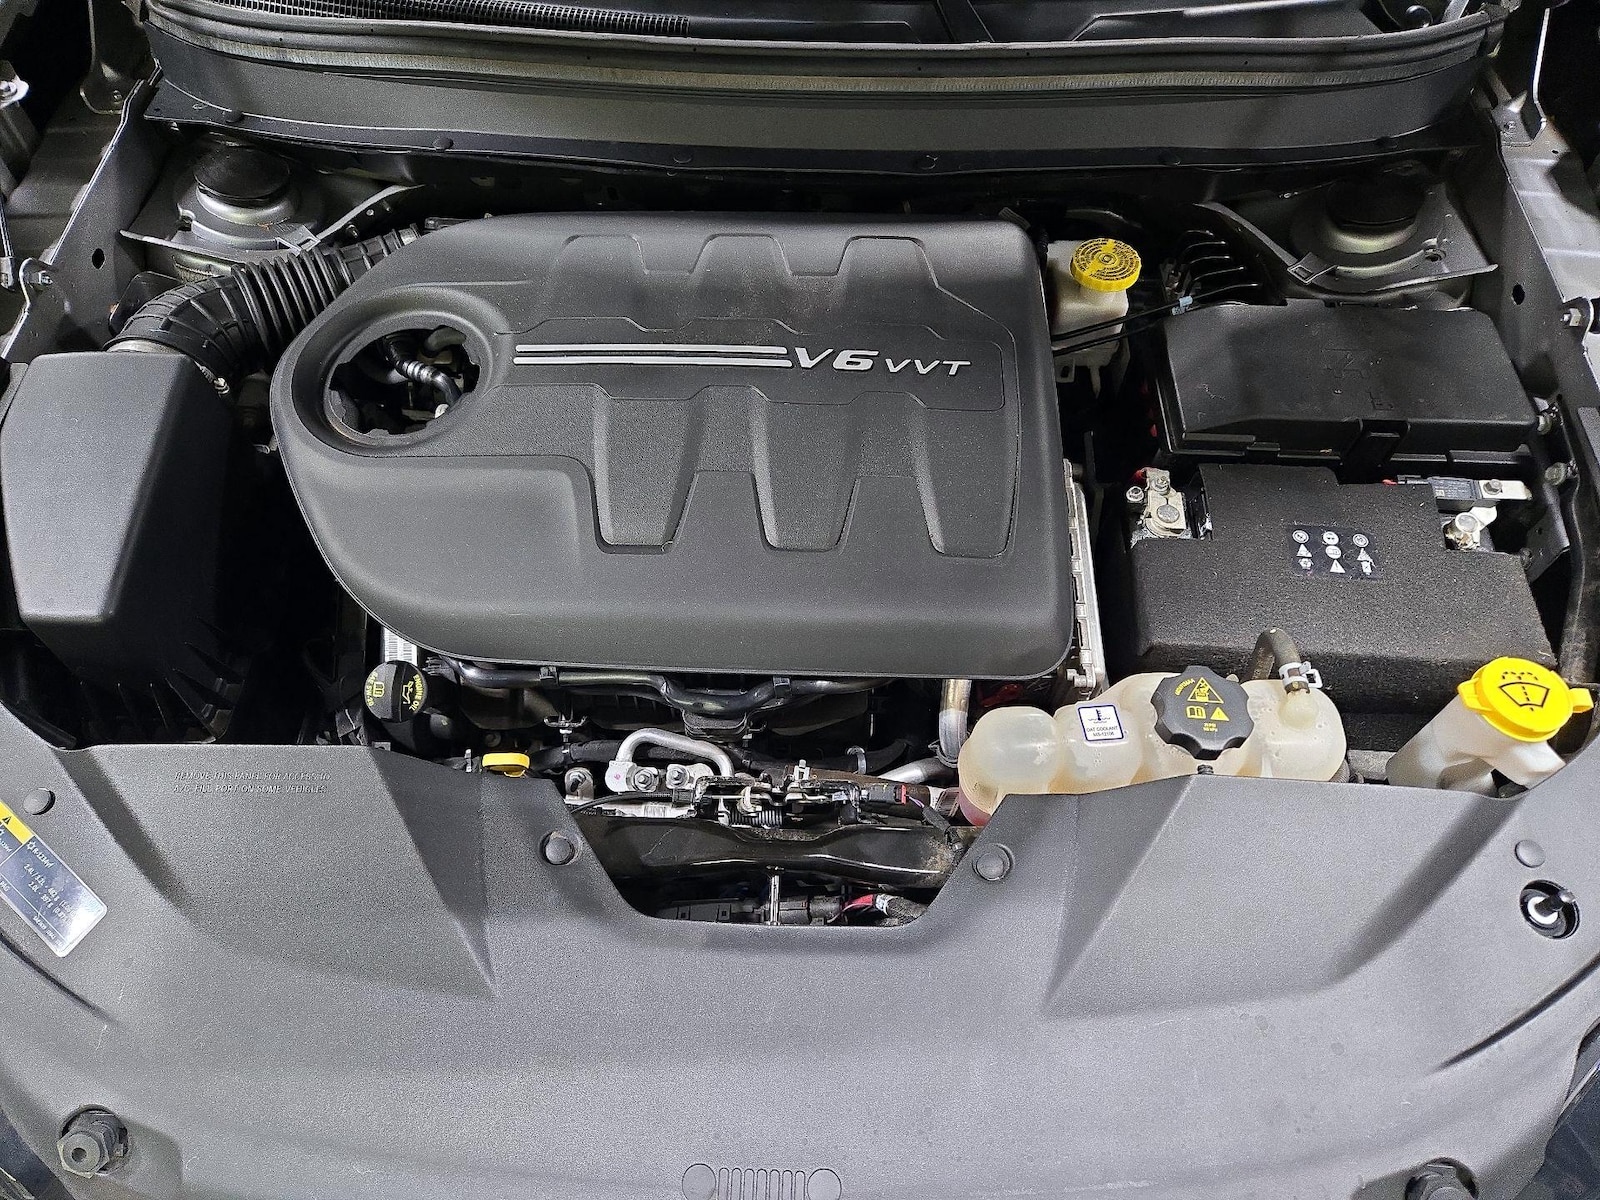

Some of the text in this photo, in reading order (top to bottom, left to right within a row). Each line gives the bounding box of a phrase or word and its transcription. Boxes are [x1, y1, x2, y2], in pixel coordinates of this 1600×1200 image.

[795, 347, 972, 376] V6 VVT
[409, 674, 423, 711] ENGINE OIL
[264, 772, 280, 781] FOR
